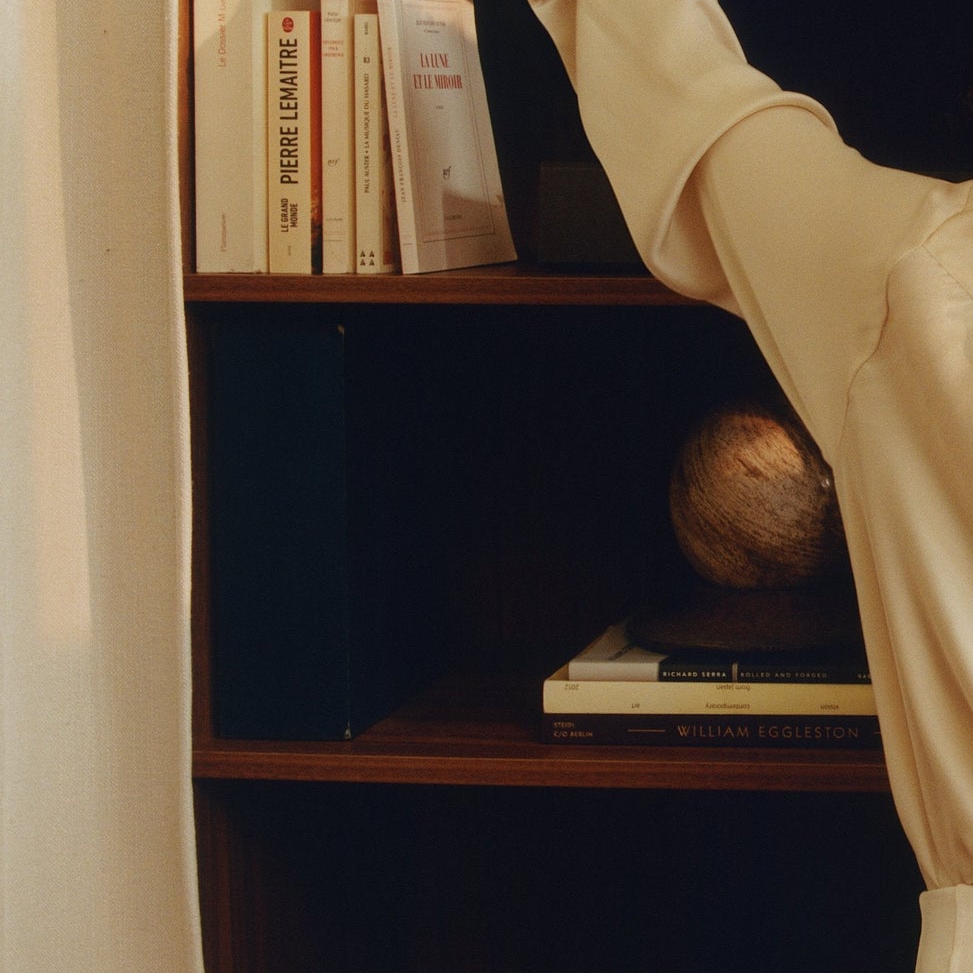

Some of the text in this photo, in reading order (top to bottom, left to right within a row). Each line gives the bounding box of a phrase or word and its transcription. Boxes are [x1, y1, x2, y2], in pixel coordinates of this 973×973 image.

[430, 52, 450, 69] LUNE
[413, 74, 463, 90] ET LE MIROIR
[279, 38, 298, 185] PIERRE LEMAITRE
[281, 198, 289, 233] LE GRAND
[290, 203, 298, 228] MONDE
[740, 671, 771, 679] ROLLED
[705, 701, 751, 710] contemporary
[677, 725, 859, 740] WILLIAM EGGLESTON
